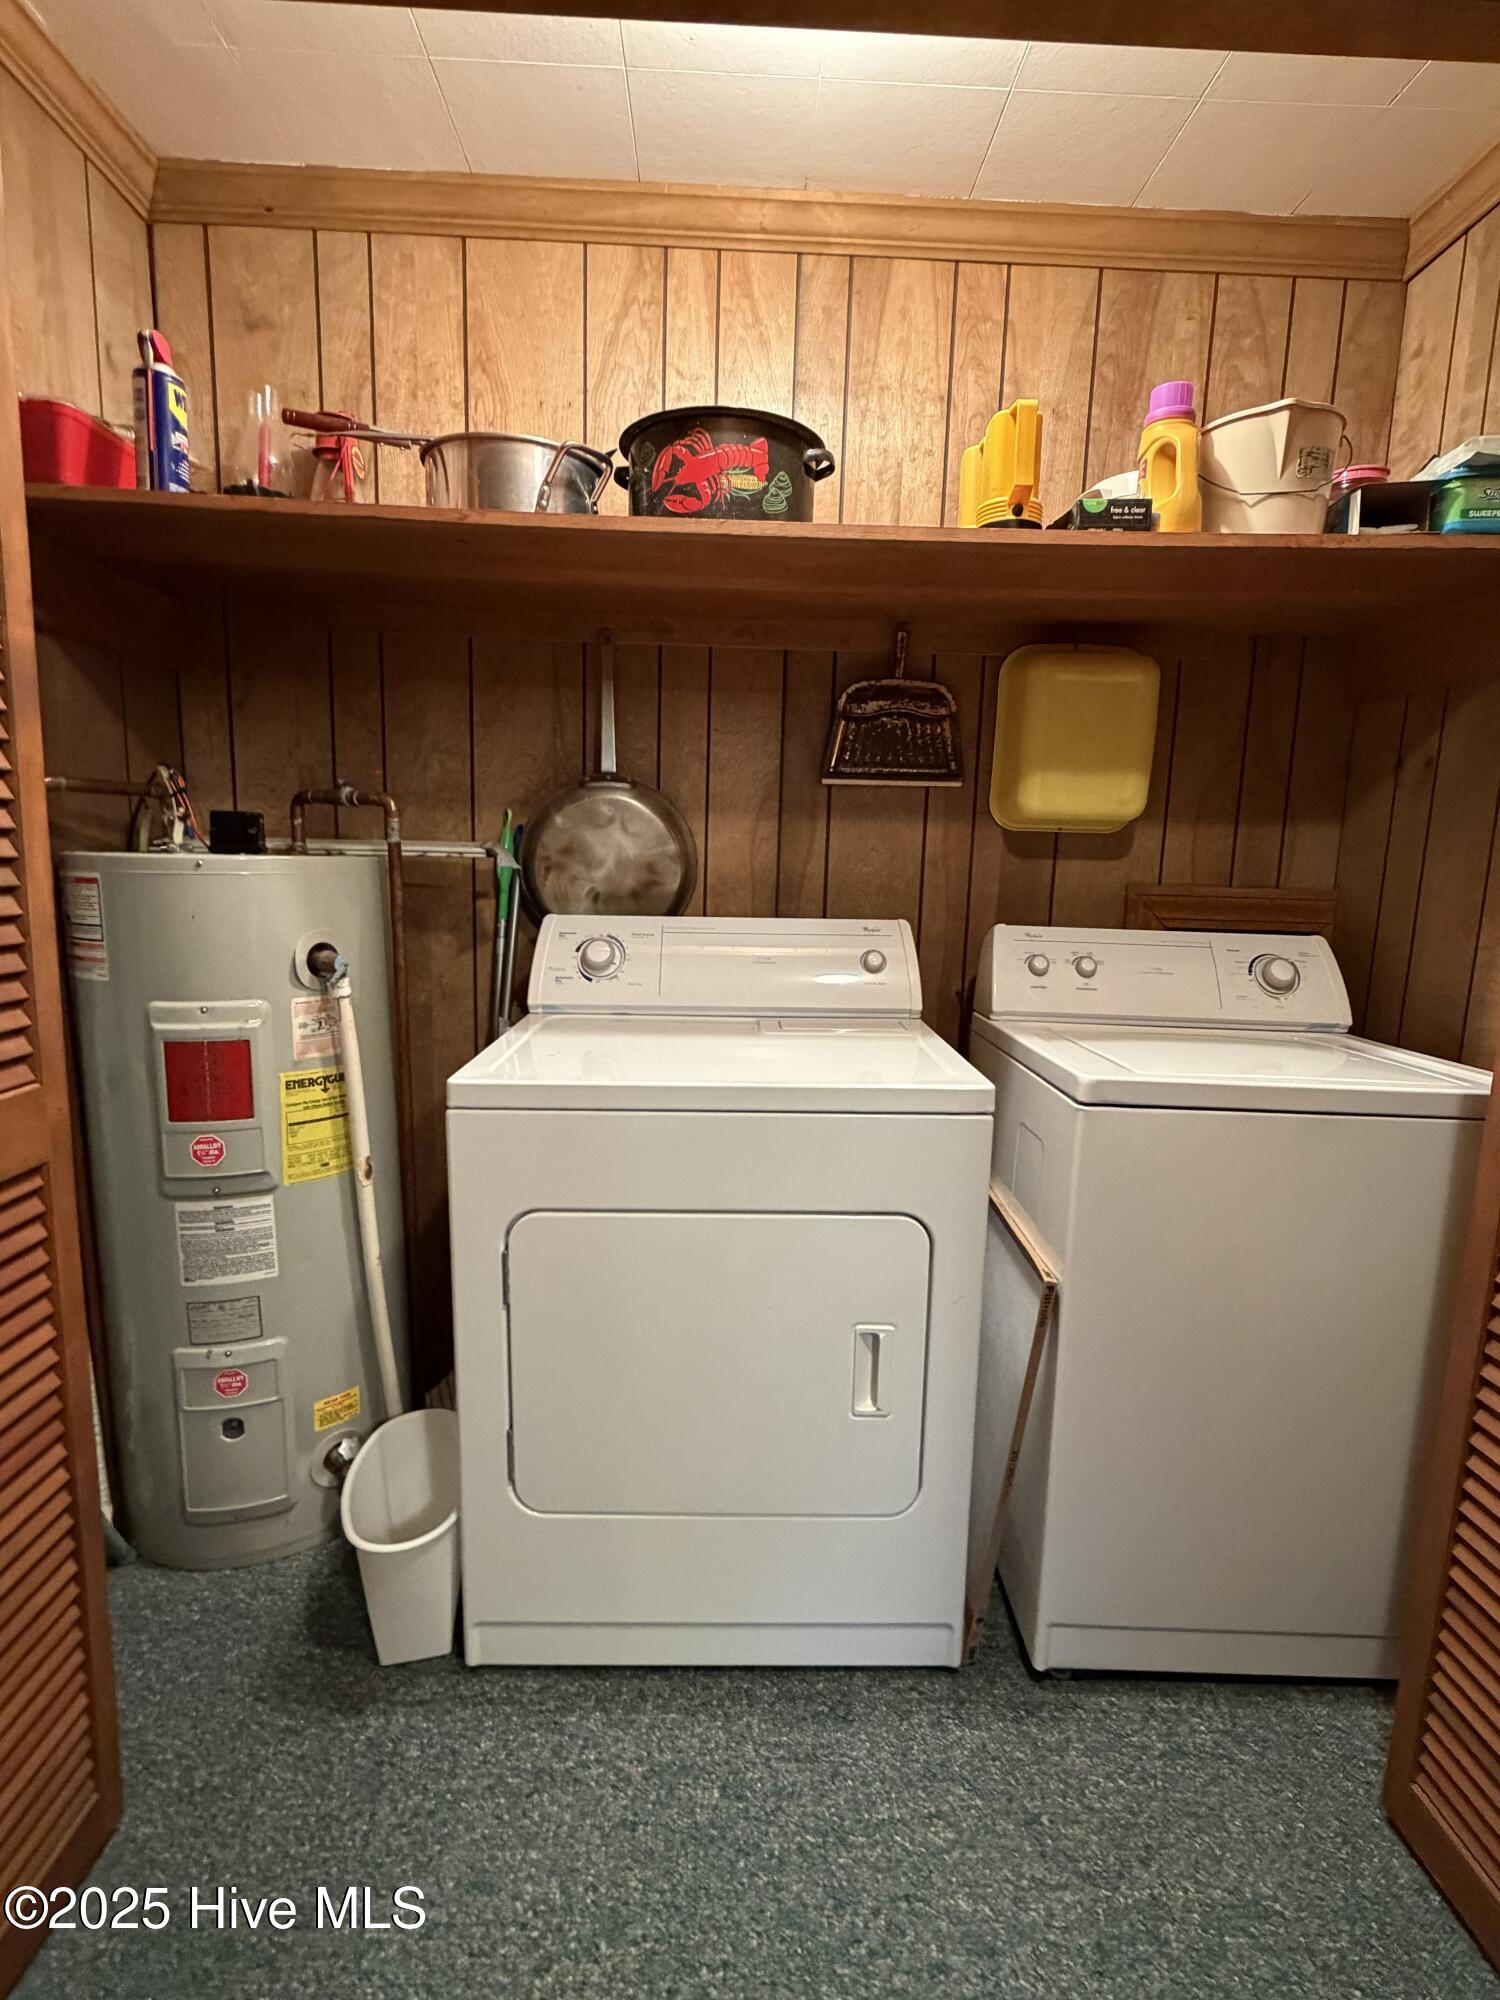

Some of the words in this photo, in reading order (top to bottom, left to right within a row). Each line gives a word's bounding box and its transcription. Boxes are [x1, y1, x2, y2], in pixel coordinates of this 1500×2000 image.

[1110, 505, 1123, 514] free
[1123, 505, 1130, 514] &
[1130, 505, 1146, 514] clear
